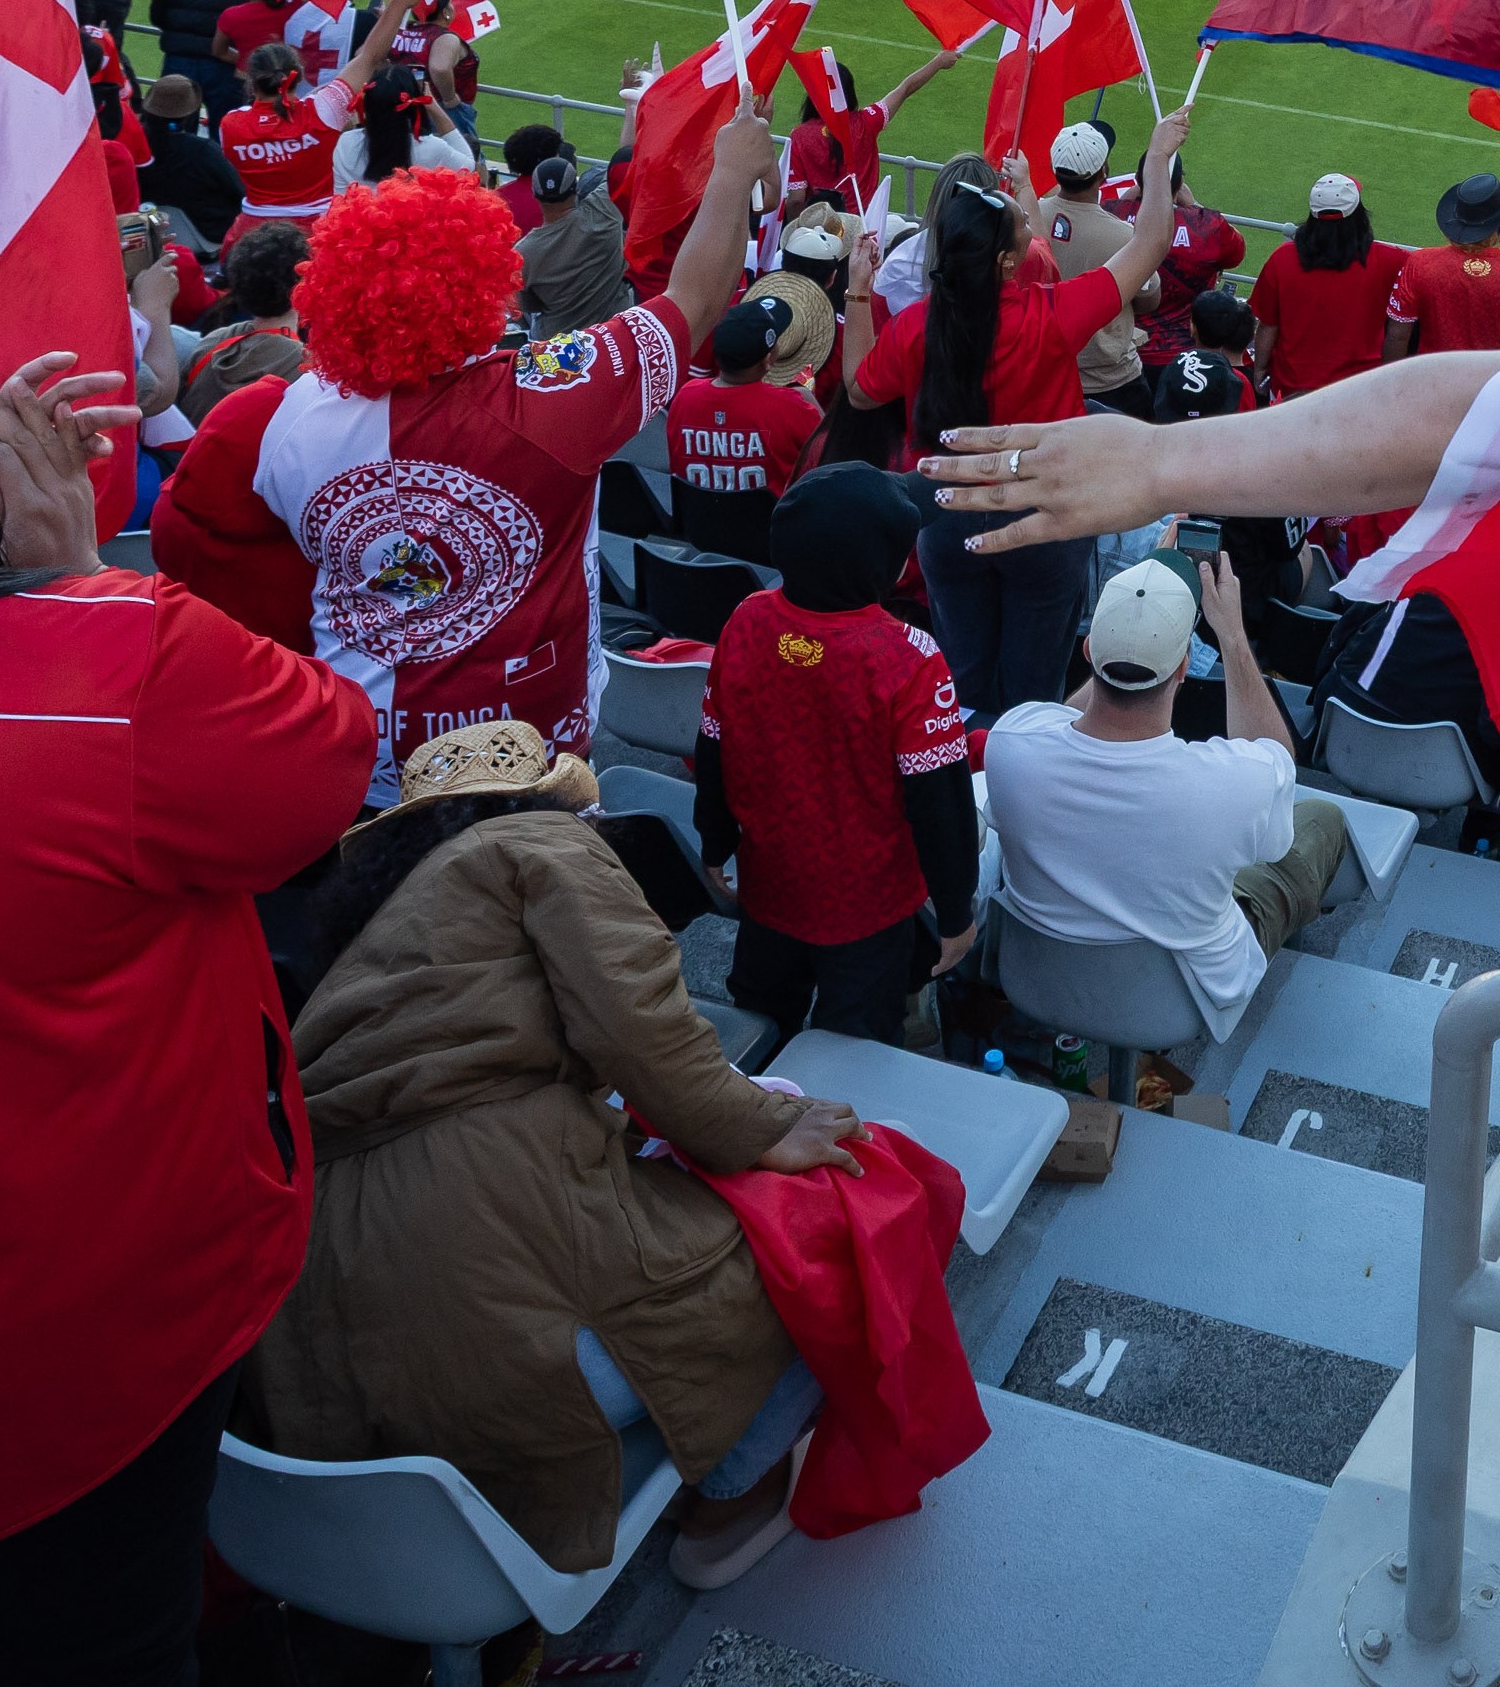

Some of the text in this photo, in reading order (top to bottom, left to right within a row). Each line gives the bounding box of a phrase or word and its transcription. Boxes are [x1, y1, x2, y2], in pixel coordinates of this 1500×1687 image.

[233, 133, 320, 162] TONGA
[603, 333, 625, 377] KINGDOM
[681, 429, 766, 458] TONGA
[375, 707, 408, 741] OF
[1421, 957, 1459, 989] H
[1276, 1109, 1323, 1149] J
[1056, 1328, 1129, 1397] K
